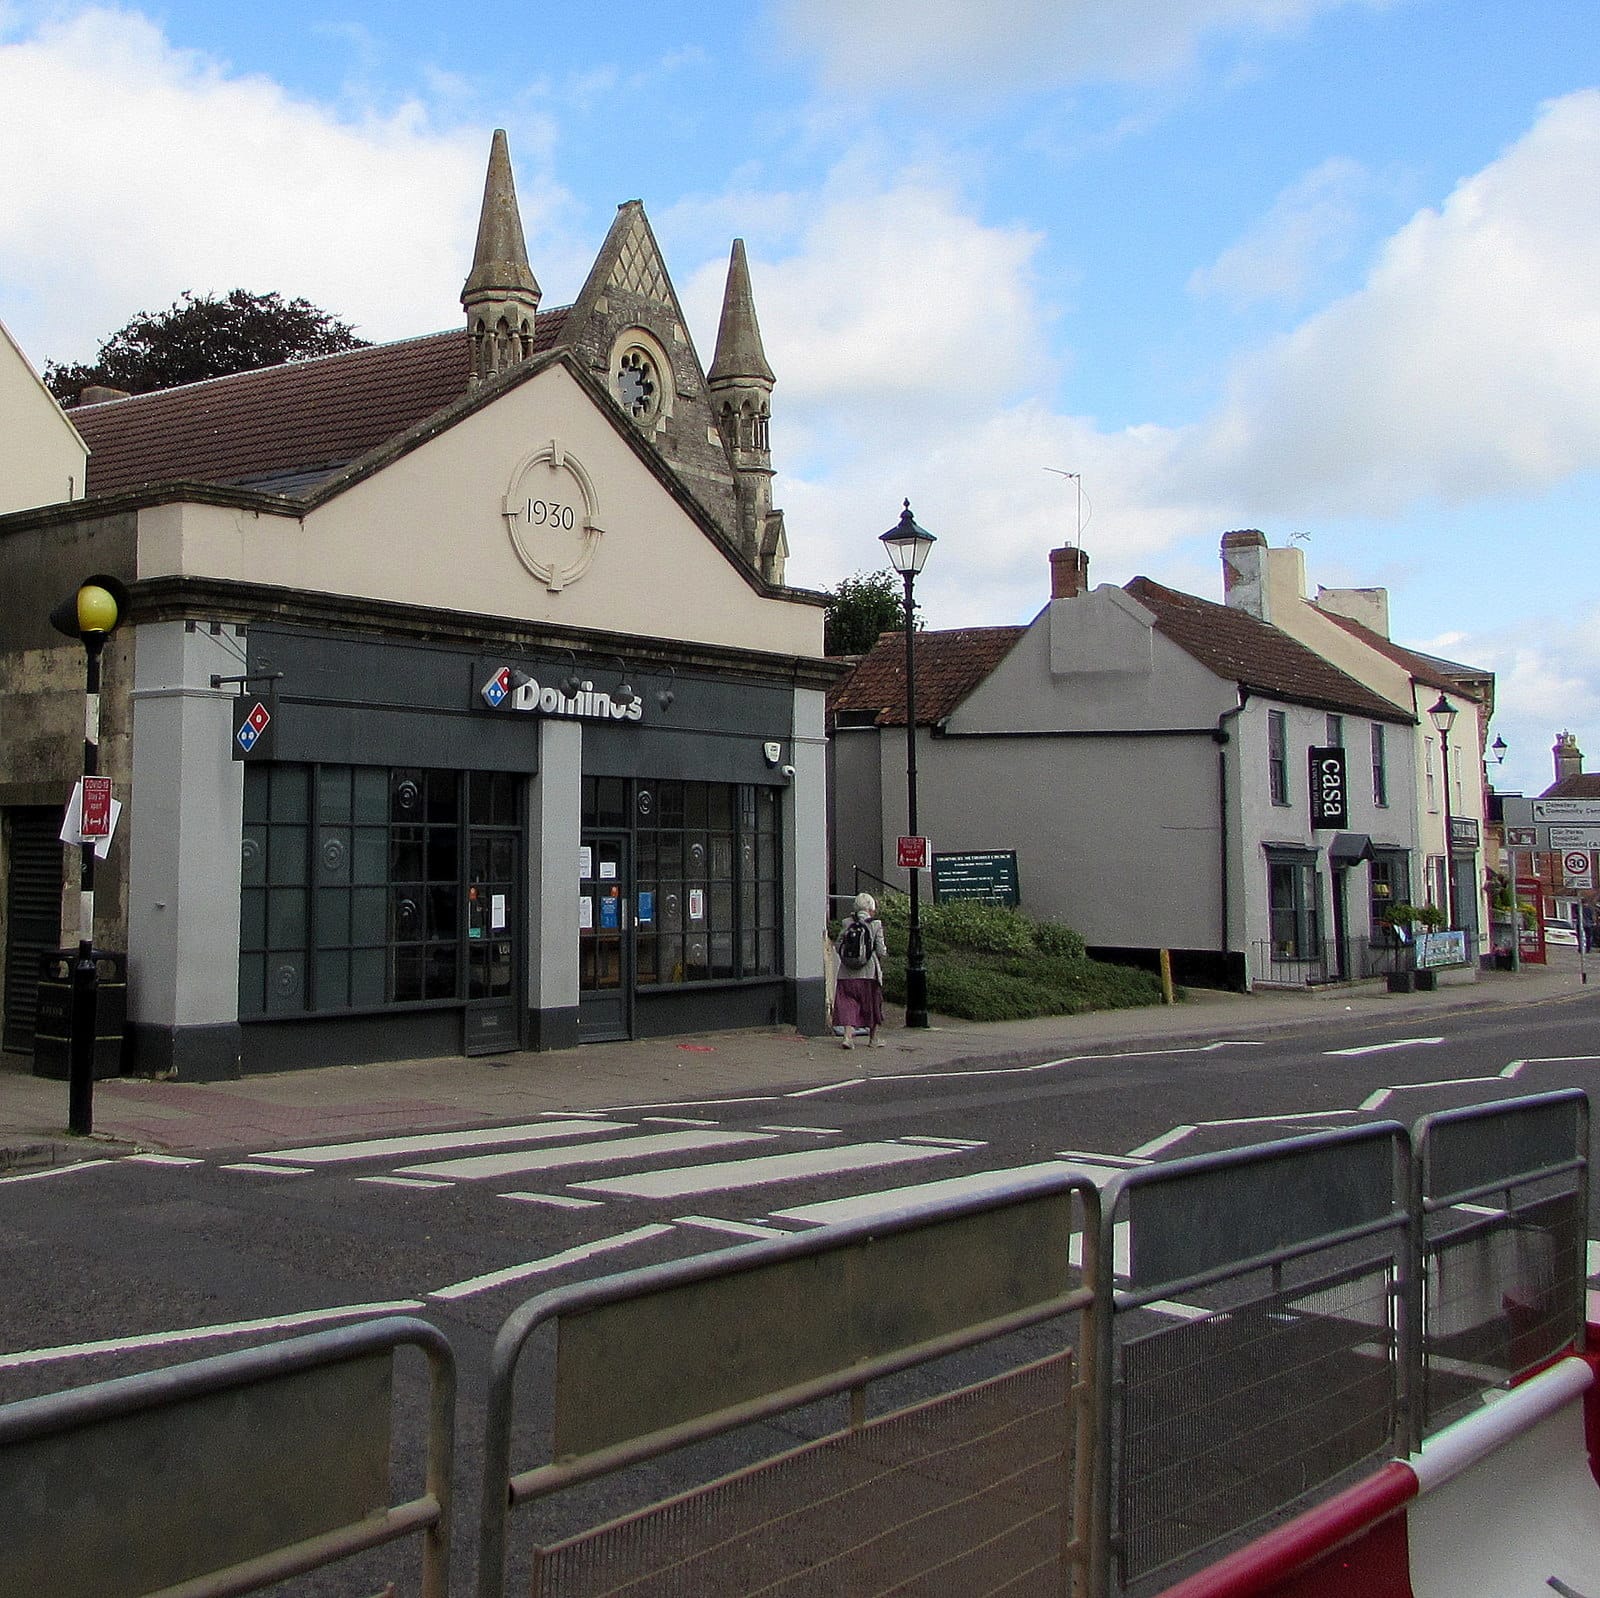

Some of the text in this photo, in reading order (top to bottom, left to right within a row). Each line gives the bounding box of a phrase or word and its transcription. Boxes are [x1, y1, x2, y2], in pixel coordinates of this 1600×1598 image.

[527, 498, 574, 530] 1930
[1322, 759, 1342, 817] casa
[1568, 858, 1585, 868] 30
